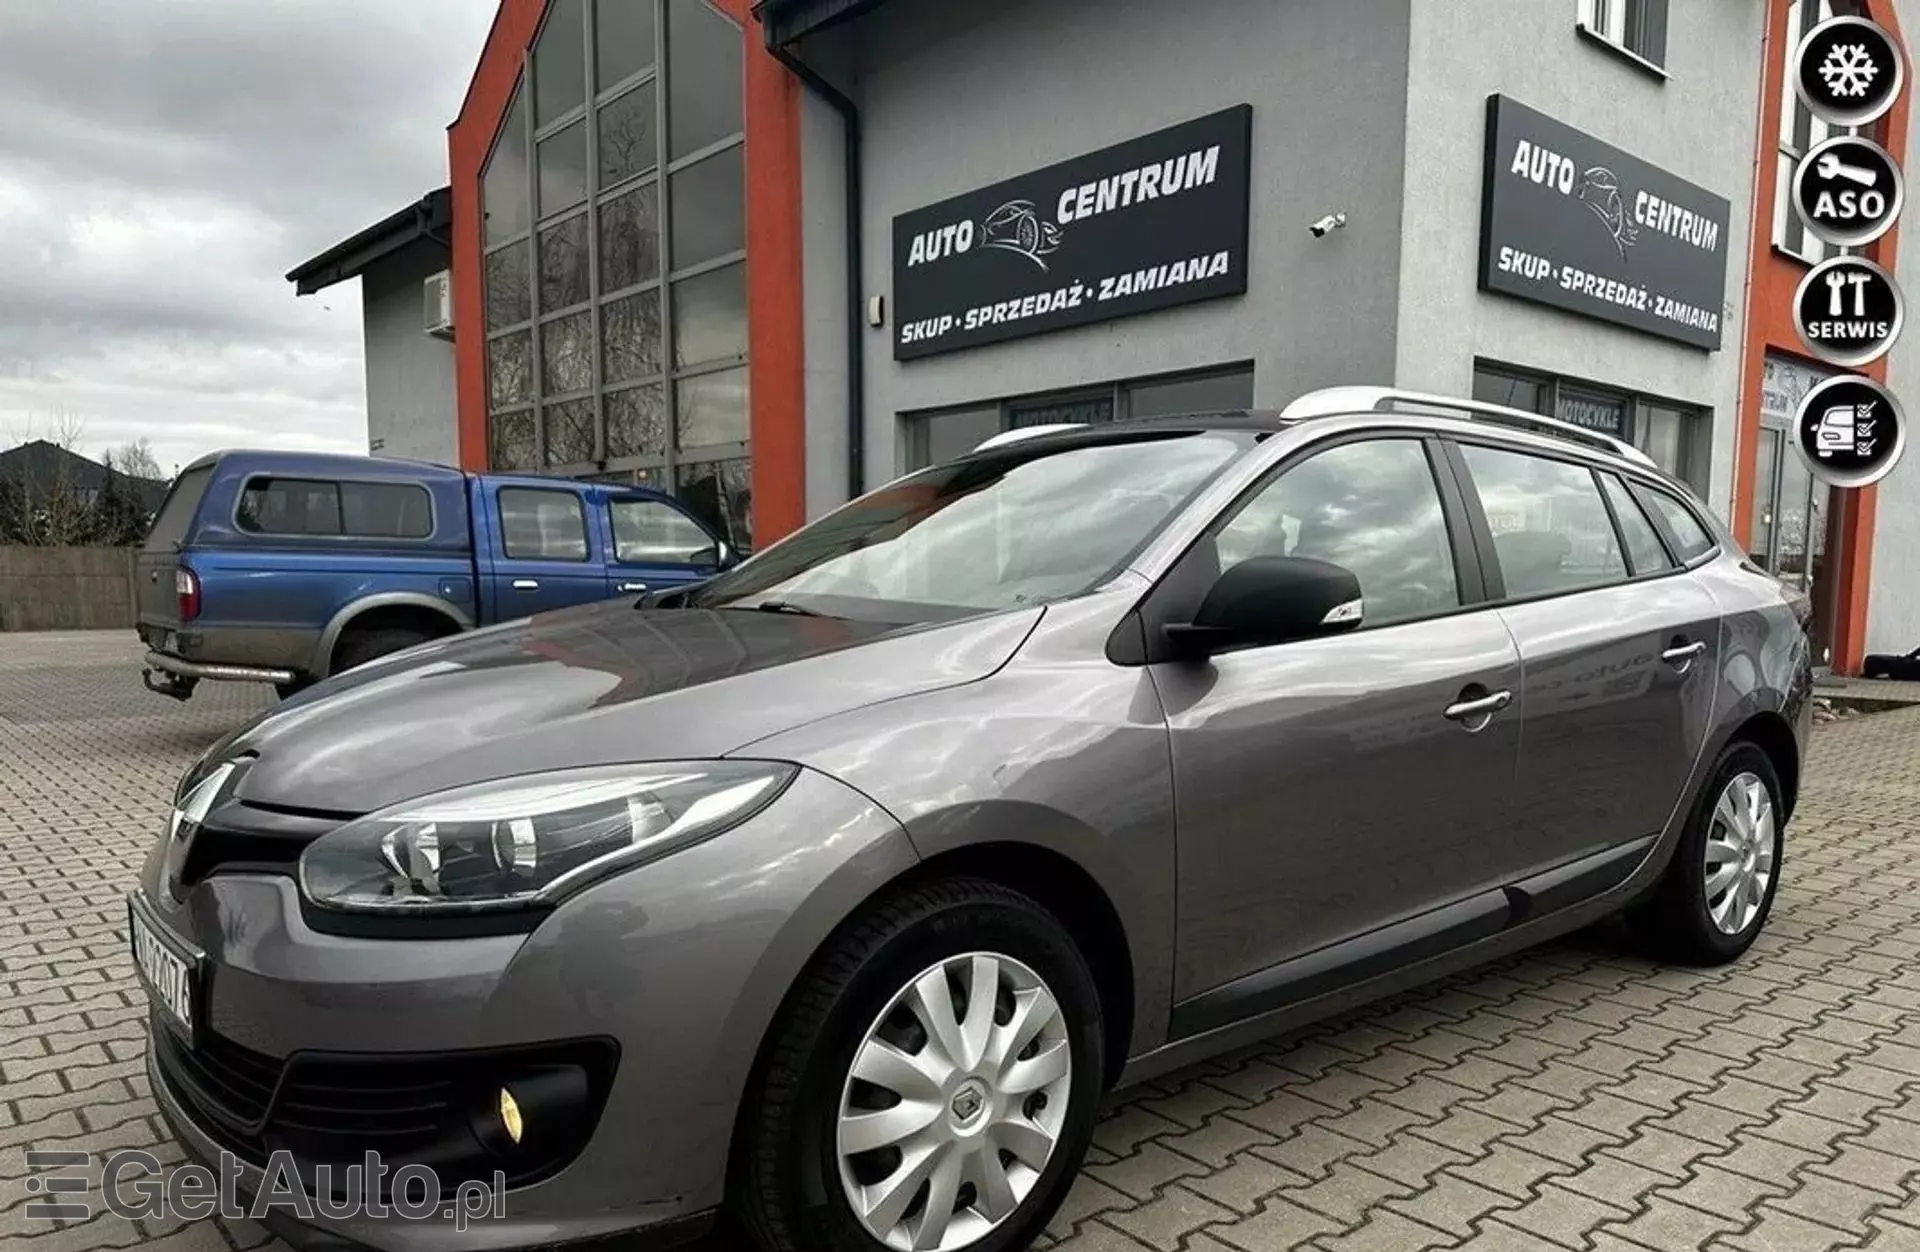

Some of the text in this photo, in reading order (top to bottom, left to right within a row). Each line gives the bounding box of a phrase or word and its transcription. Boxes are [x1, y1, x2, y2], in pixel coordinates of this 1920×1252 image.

[907, 145, 1221, 267] AUTO CENTRUM
[1510, 139, 1719, 252] AUTO CENTRUM
[900, 249, 1230, 344] SKUP SPRZEDAŻ ZAMIANA
[1498, 246, 1718, 334] SKUP SPRZEDAŻ ZAMIANA
[1555, 399, 1620, 430] MOTOCYKLE
